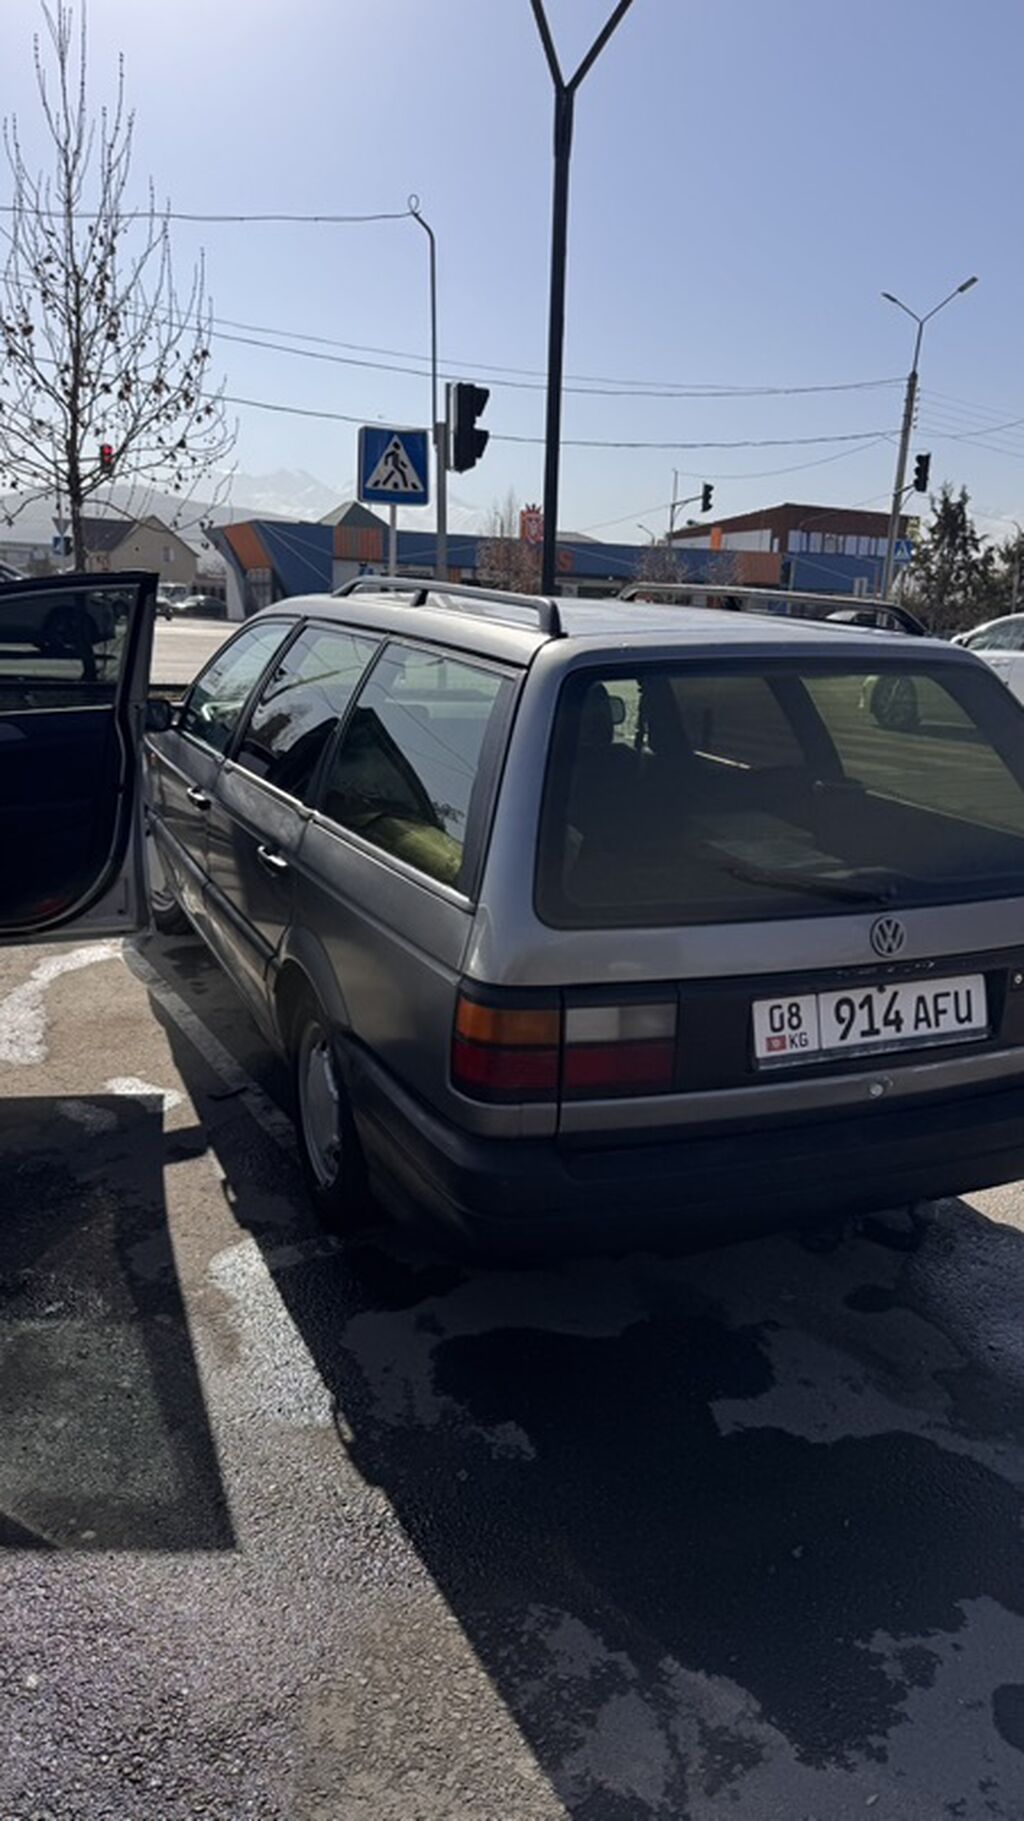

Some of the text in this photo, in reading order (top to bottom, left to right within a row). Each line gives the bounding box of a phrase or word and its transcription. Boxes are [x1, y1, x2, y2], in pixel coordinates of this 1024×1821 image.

[769, 989, 973, 1041] 08 914 AFU
[789, 1032, 809, 1049] KG
